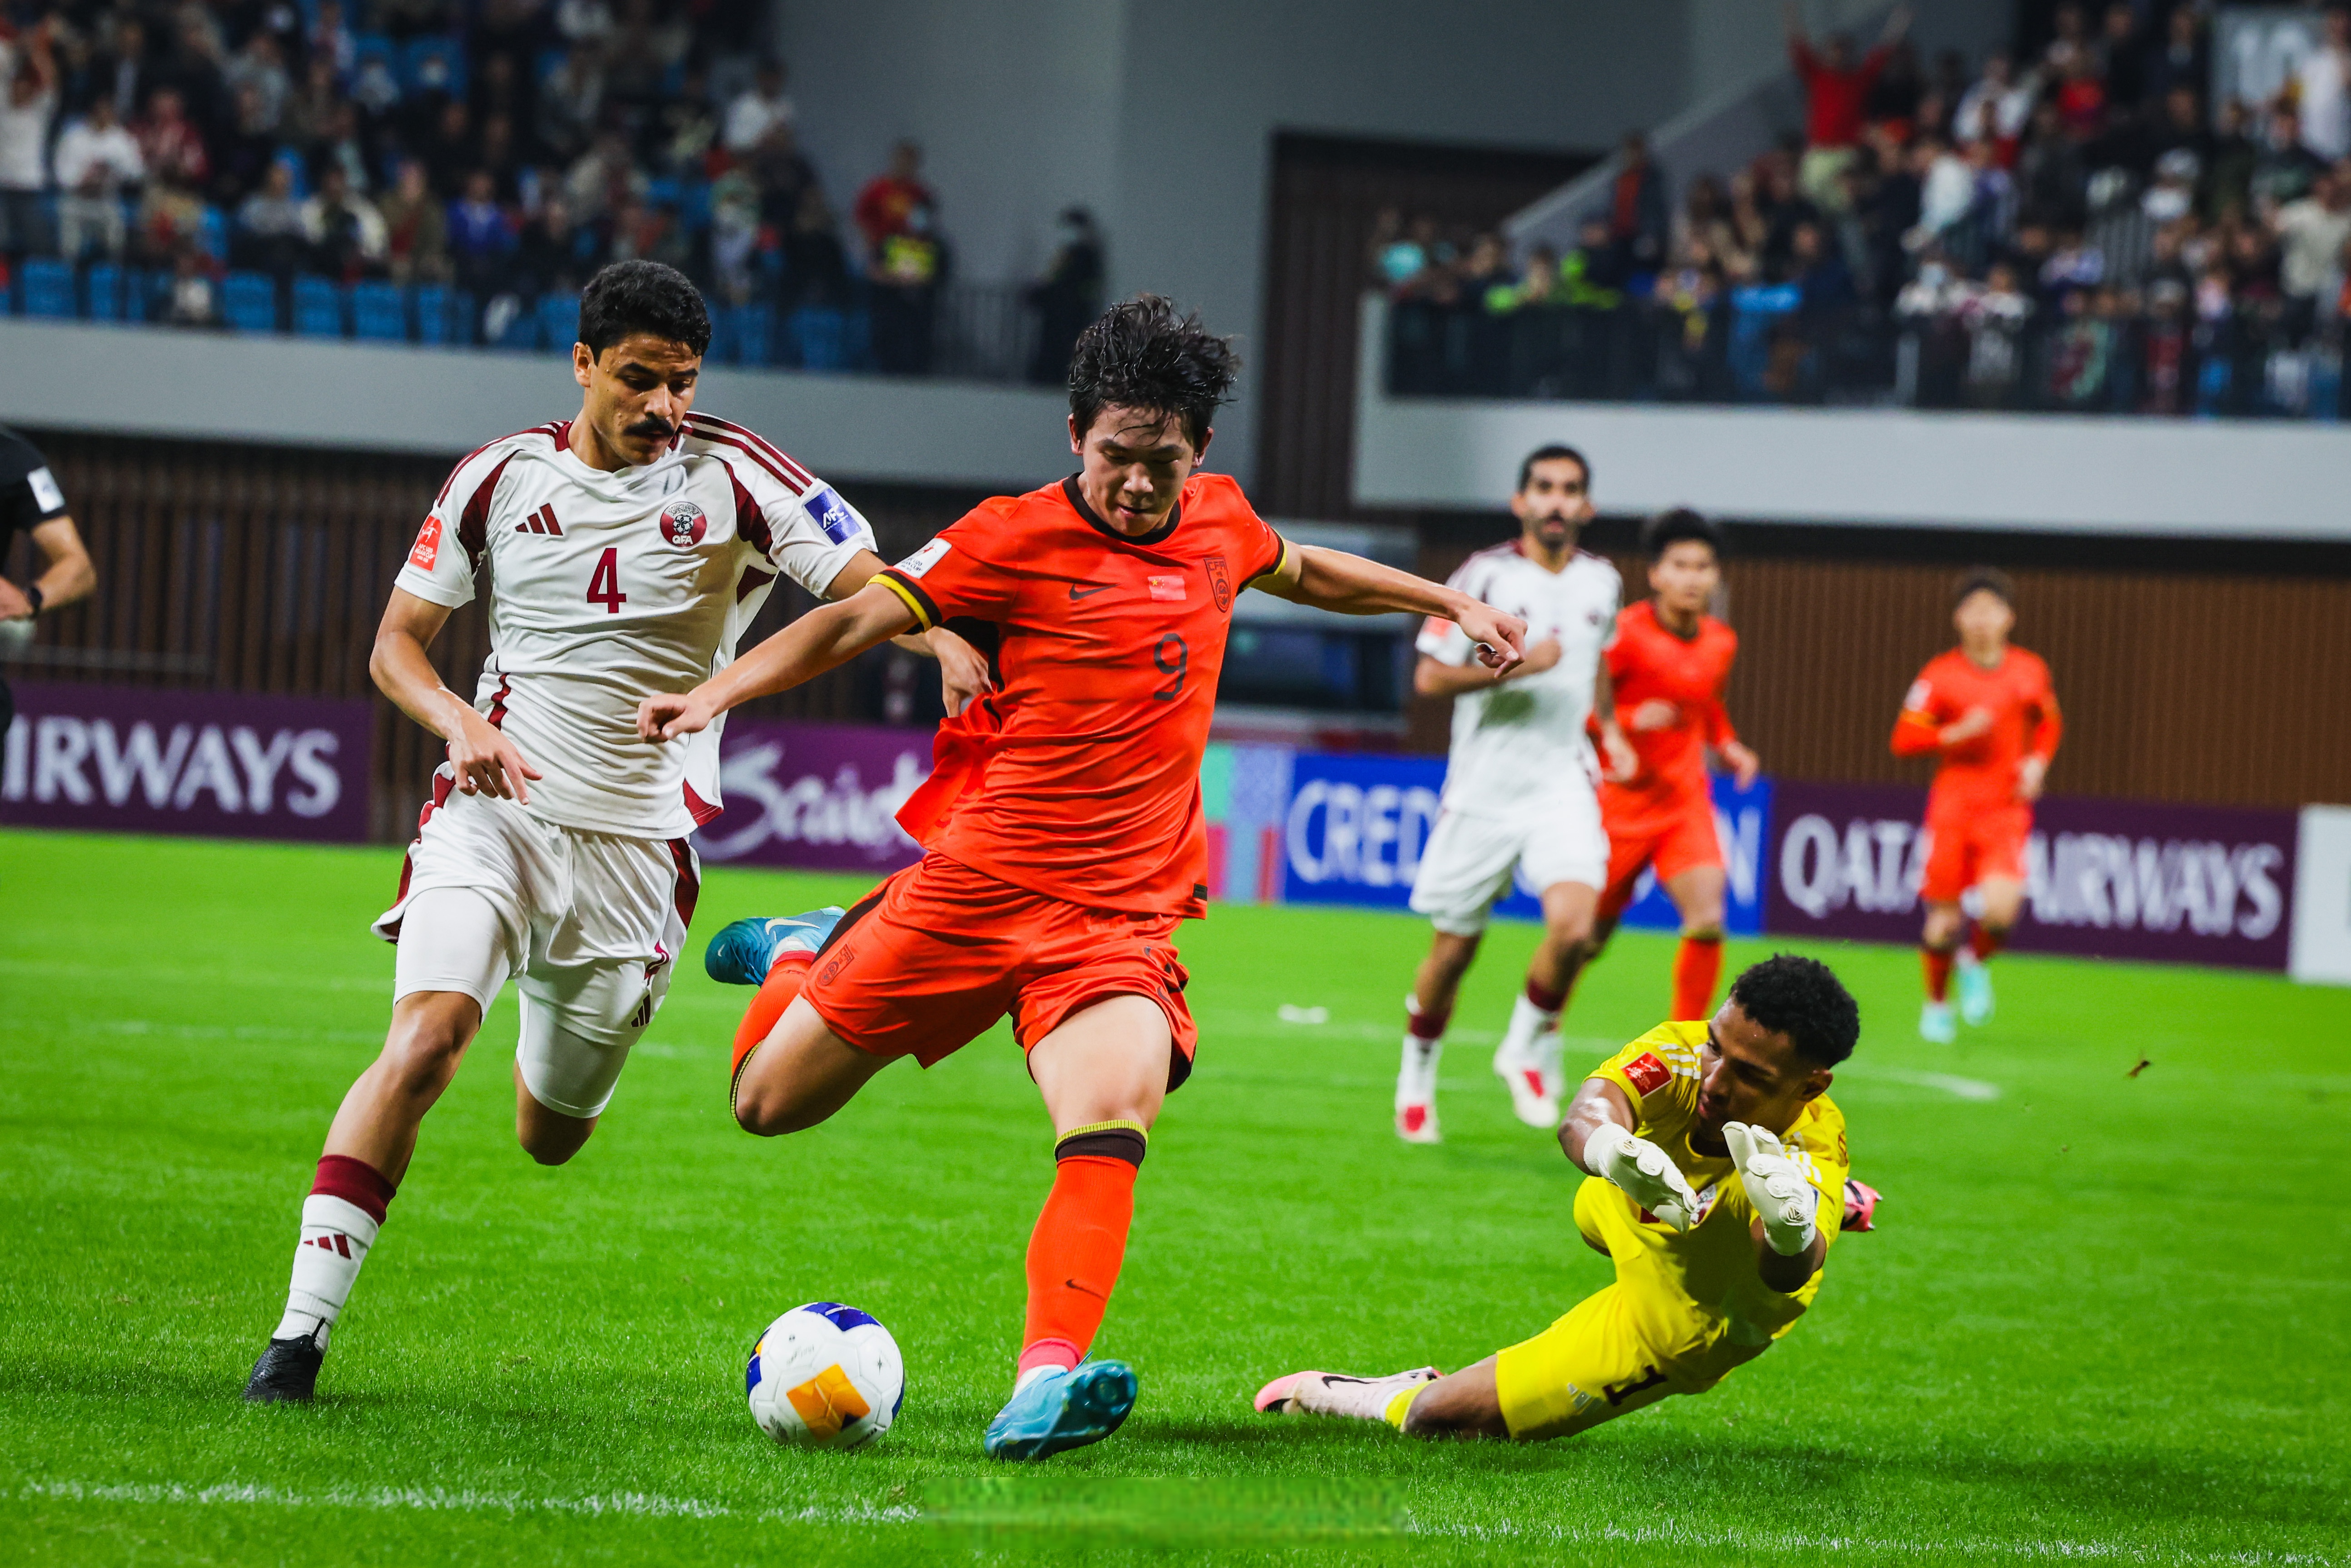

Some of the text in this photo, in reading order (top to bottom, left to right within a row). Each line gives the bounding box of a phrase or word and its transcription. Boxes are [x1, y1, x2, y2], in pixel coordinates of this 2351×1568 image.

[823, 503, 844, 528] AFC
[414, 548, 426, 557] ASIAN
[418, 543, 426, 551] AFC
[672, 535, 693, 544] QFA
[587, 548, 627, 613] 4
[1207, 561, 1226, 571] CFA
[1153, 633, 1188, 701] 9
[2, 713, 341, 818] IRWAYS
[1286, 778, 1441, 888] CRED
[1779, 813, 1935, 920] QATA
[1602, 1364, 1668, 1407] 1
